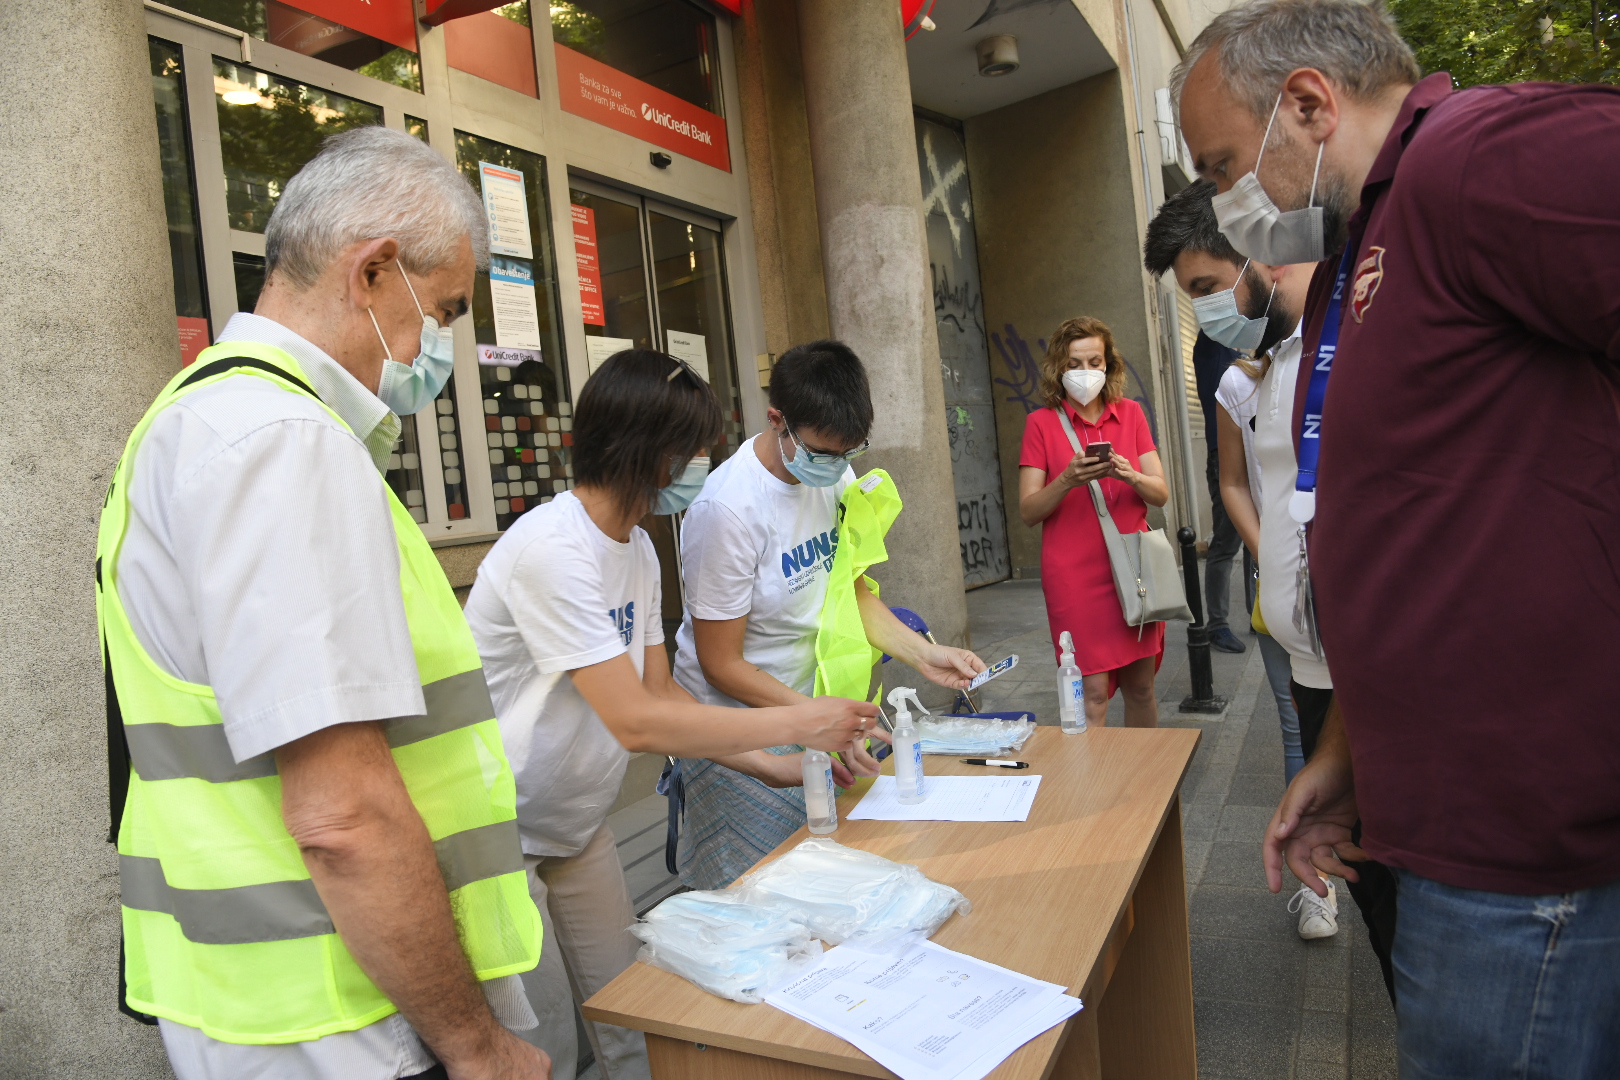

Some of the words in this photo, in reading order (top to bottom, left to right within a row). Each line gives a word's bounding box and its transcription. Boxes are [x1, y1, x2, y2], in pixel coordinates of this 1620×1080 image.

[579, 73, 601, 91] Banka
[602, 84, 610, 95] za
[611, 88, 622, 99] sve
[581, 86, 593, 100] što
[593, 95, 609, 107] vam
[609, 99, 616, 111] je
[616, 103, 637, 119] važno.
[651, 107, 691, 137] UniCredit
[691, 124, 712, 146] Bank
[492, 265, 531, 281] Obaveštenje
[1333, 273, 1345, 300] N1
[1315, 345, 1336, 371] N1
[1303, 413, 1322, 438] N1
